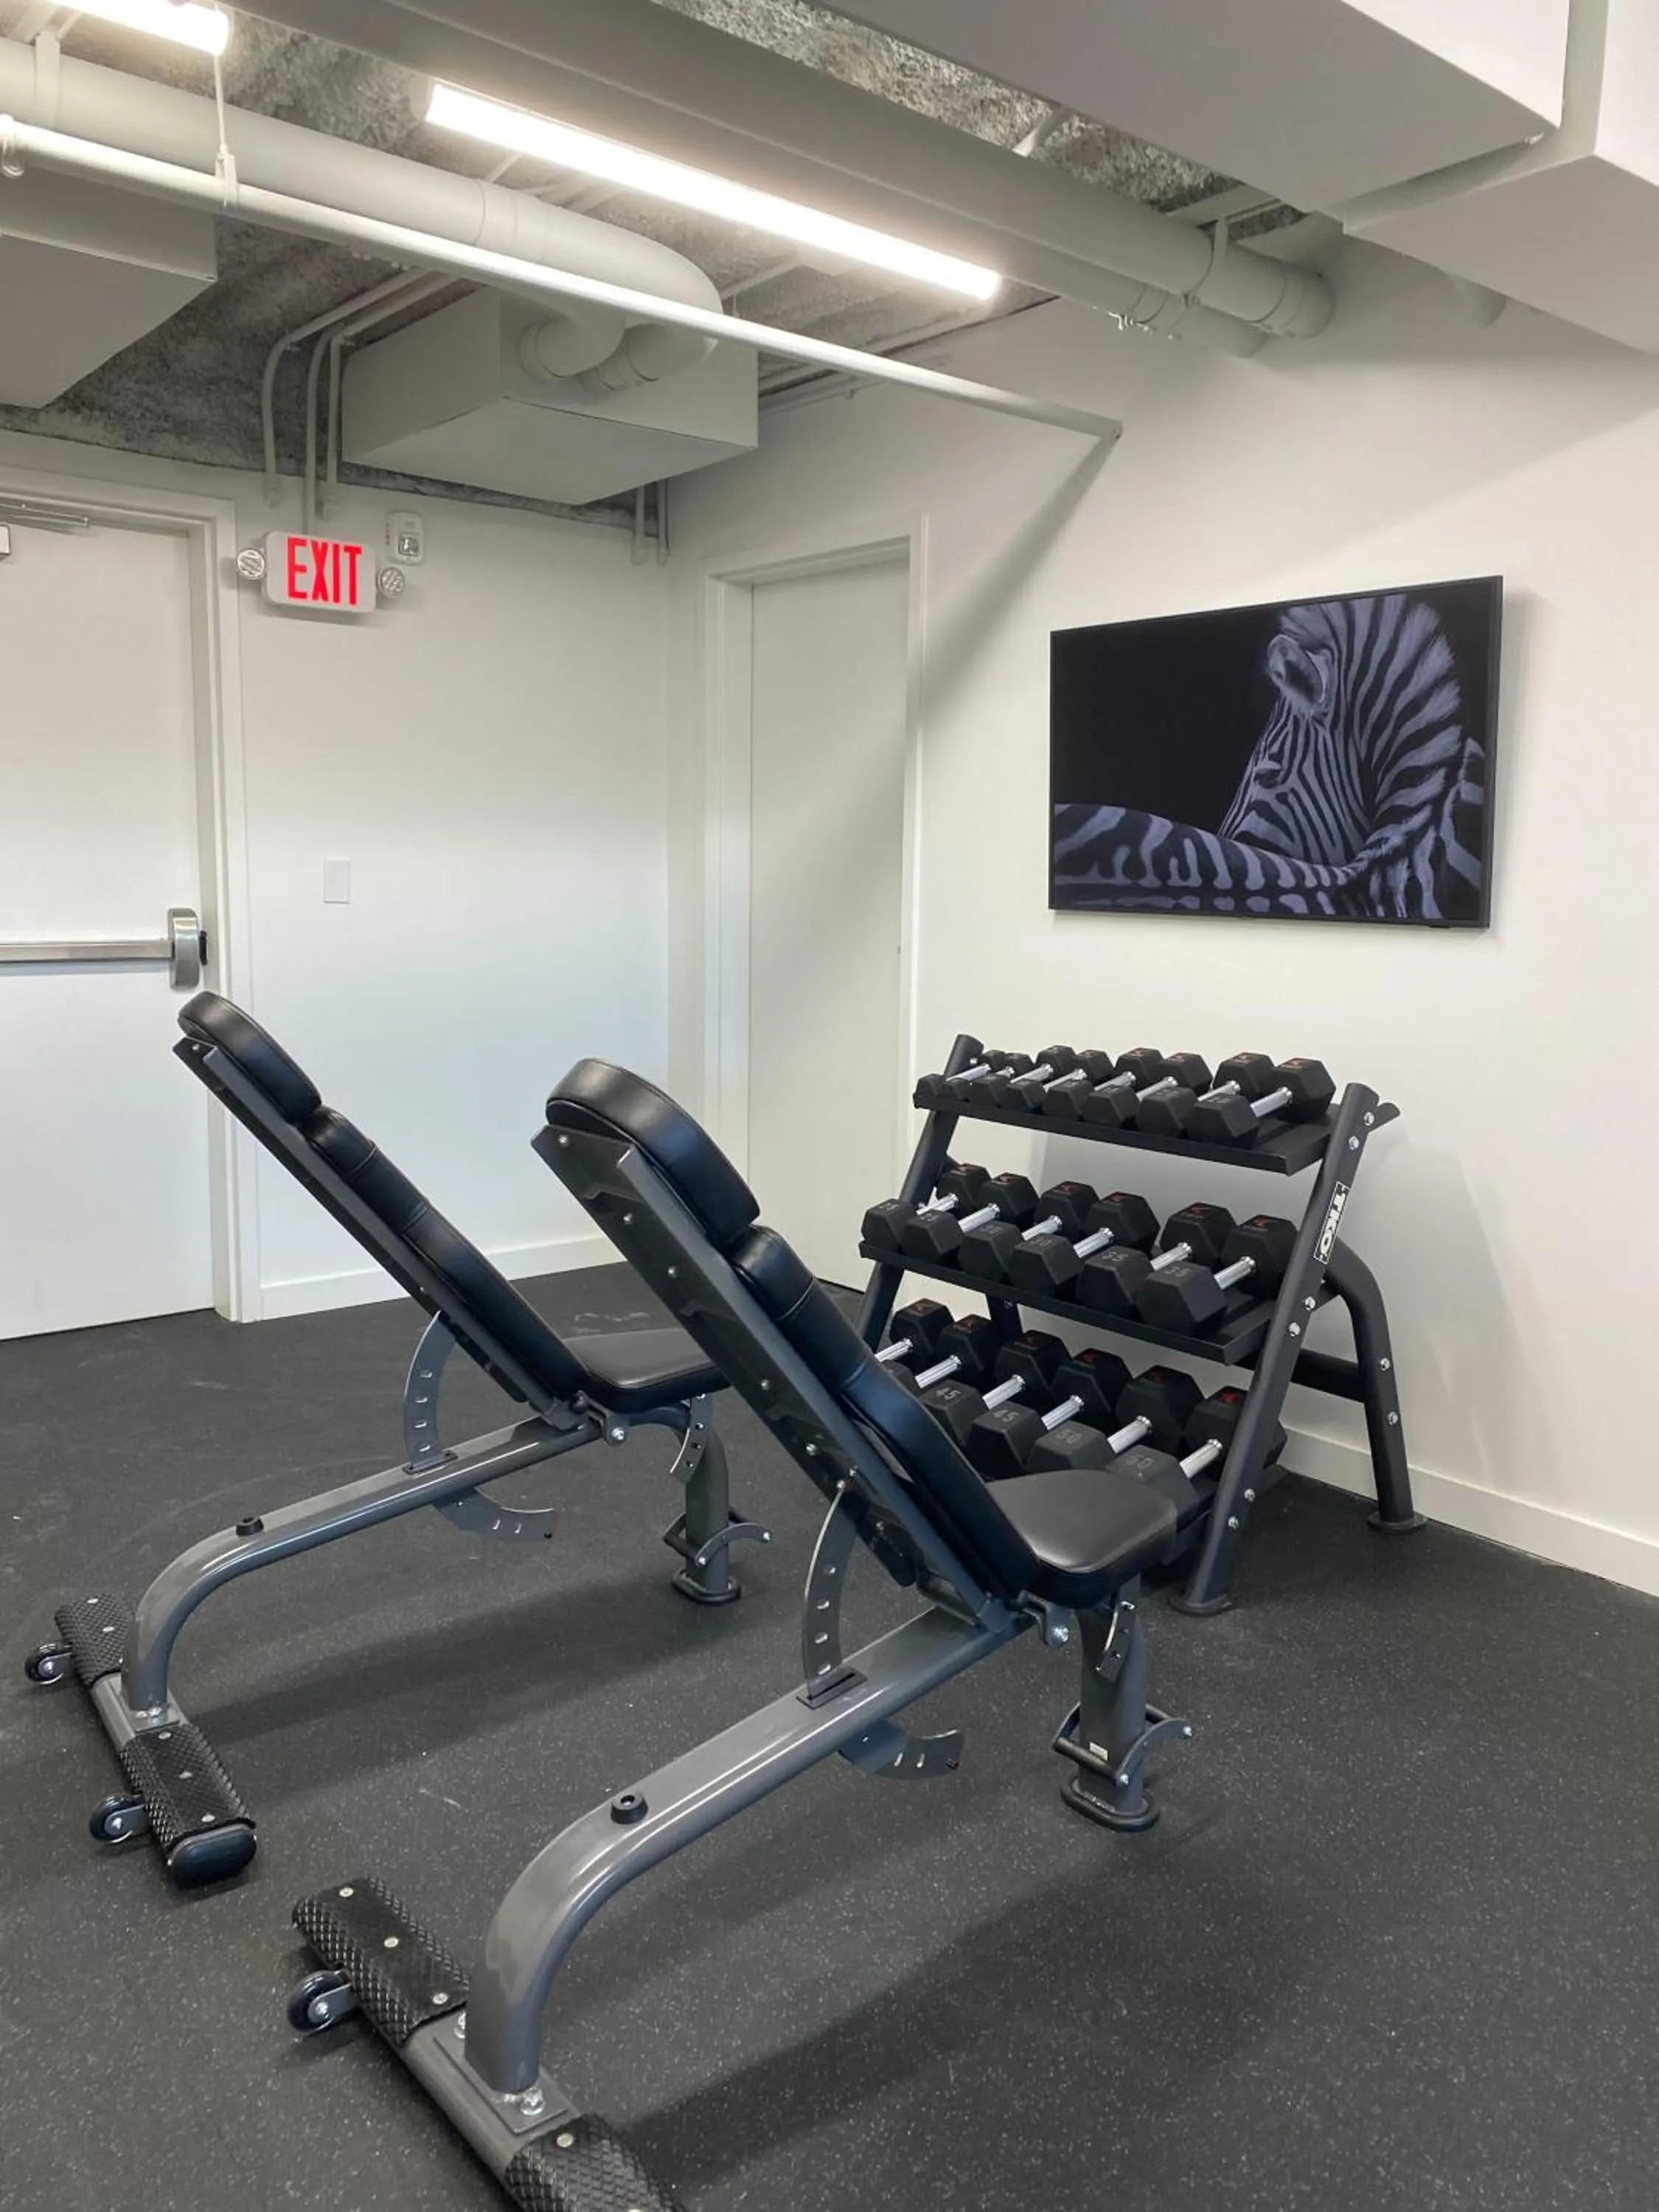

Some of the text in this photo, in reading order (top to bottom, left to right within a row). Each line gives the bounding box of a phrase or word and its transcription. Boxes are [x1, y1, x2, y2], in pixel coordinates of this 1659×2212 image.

[287, 537, 362, 605] EXIT
[1320, 1193, 1346, 1256] TKO
[935, 1387, 961, 1402] 45
[992, 1408, 1021, 1424] 45
